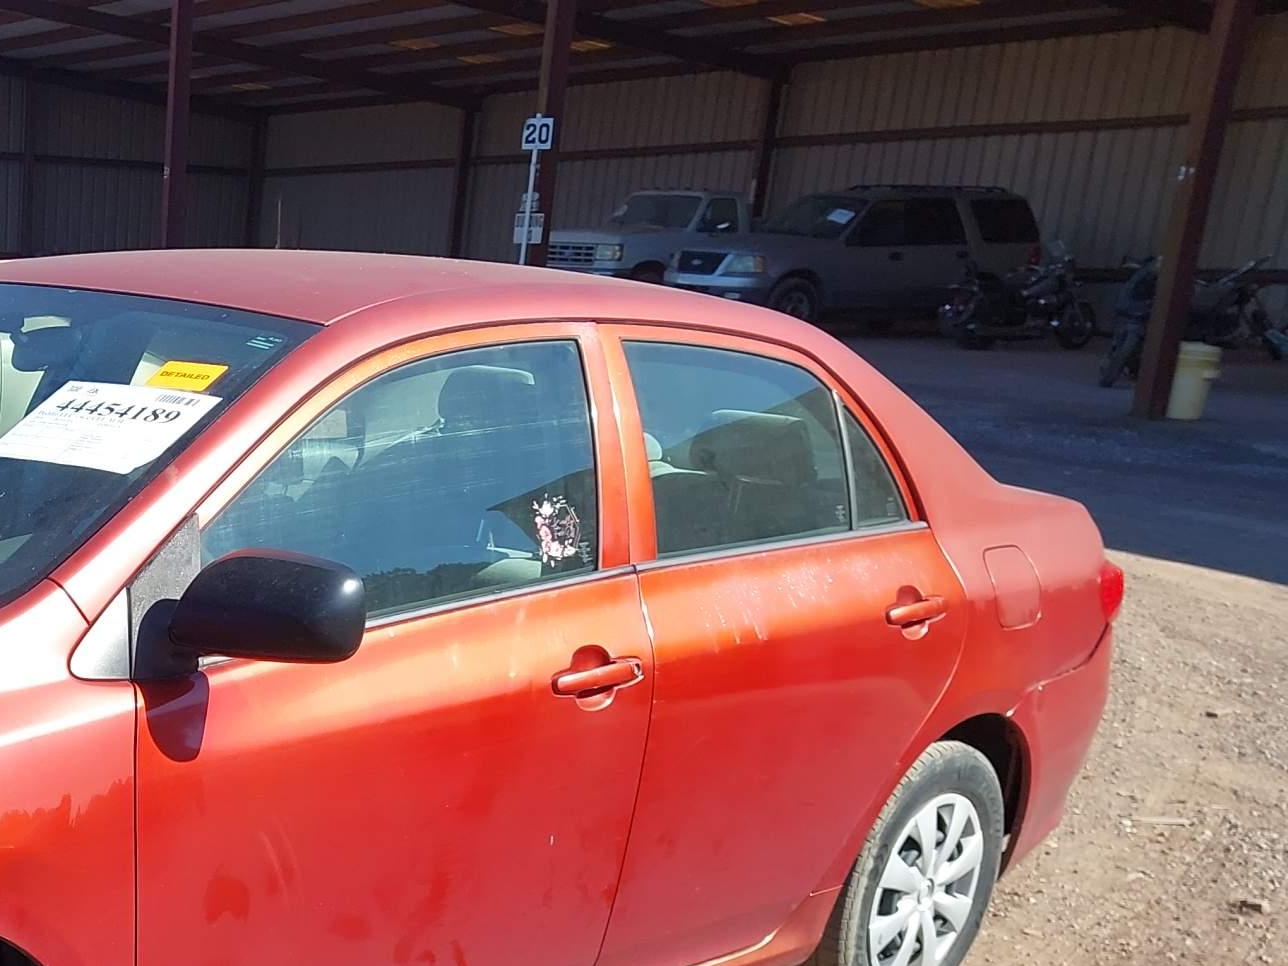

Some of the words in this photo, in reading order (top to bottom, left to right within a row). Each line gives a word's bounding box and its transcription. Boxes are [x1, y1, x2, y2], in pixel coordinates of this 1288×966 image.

[524, 122, 551, 145] 20
[159, 370, 210, 381] DETAILED
[56, 398, 182, 424] 44454189
